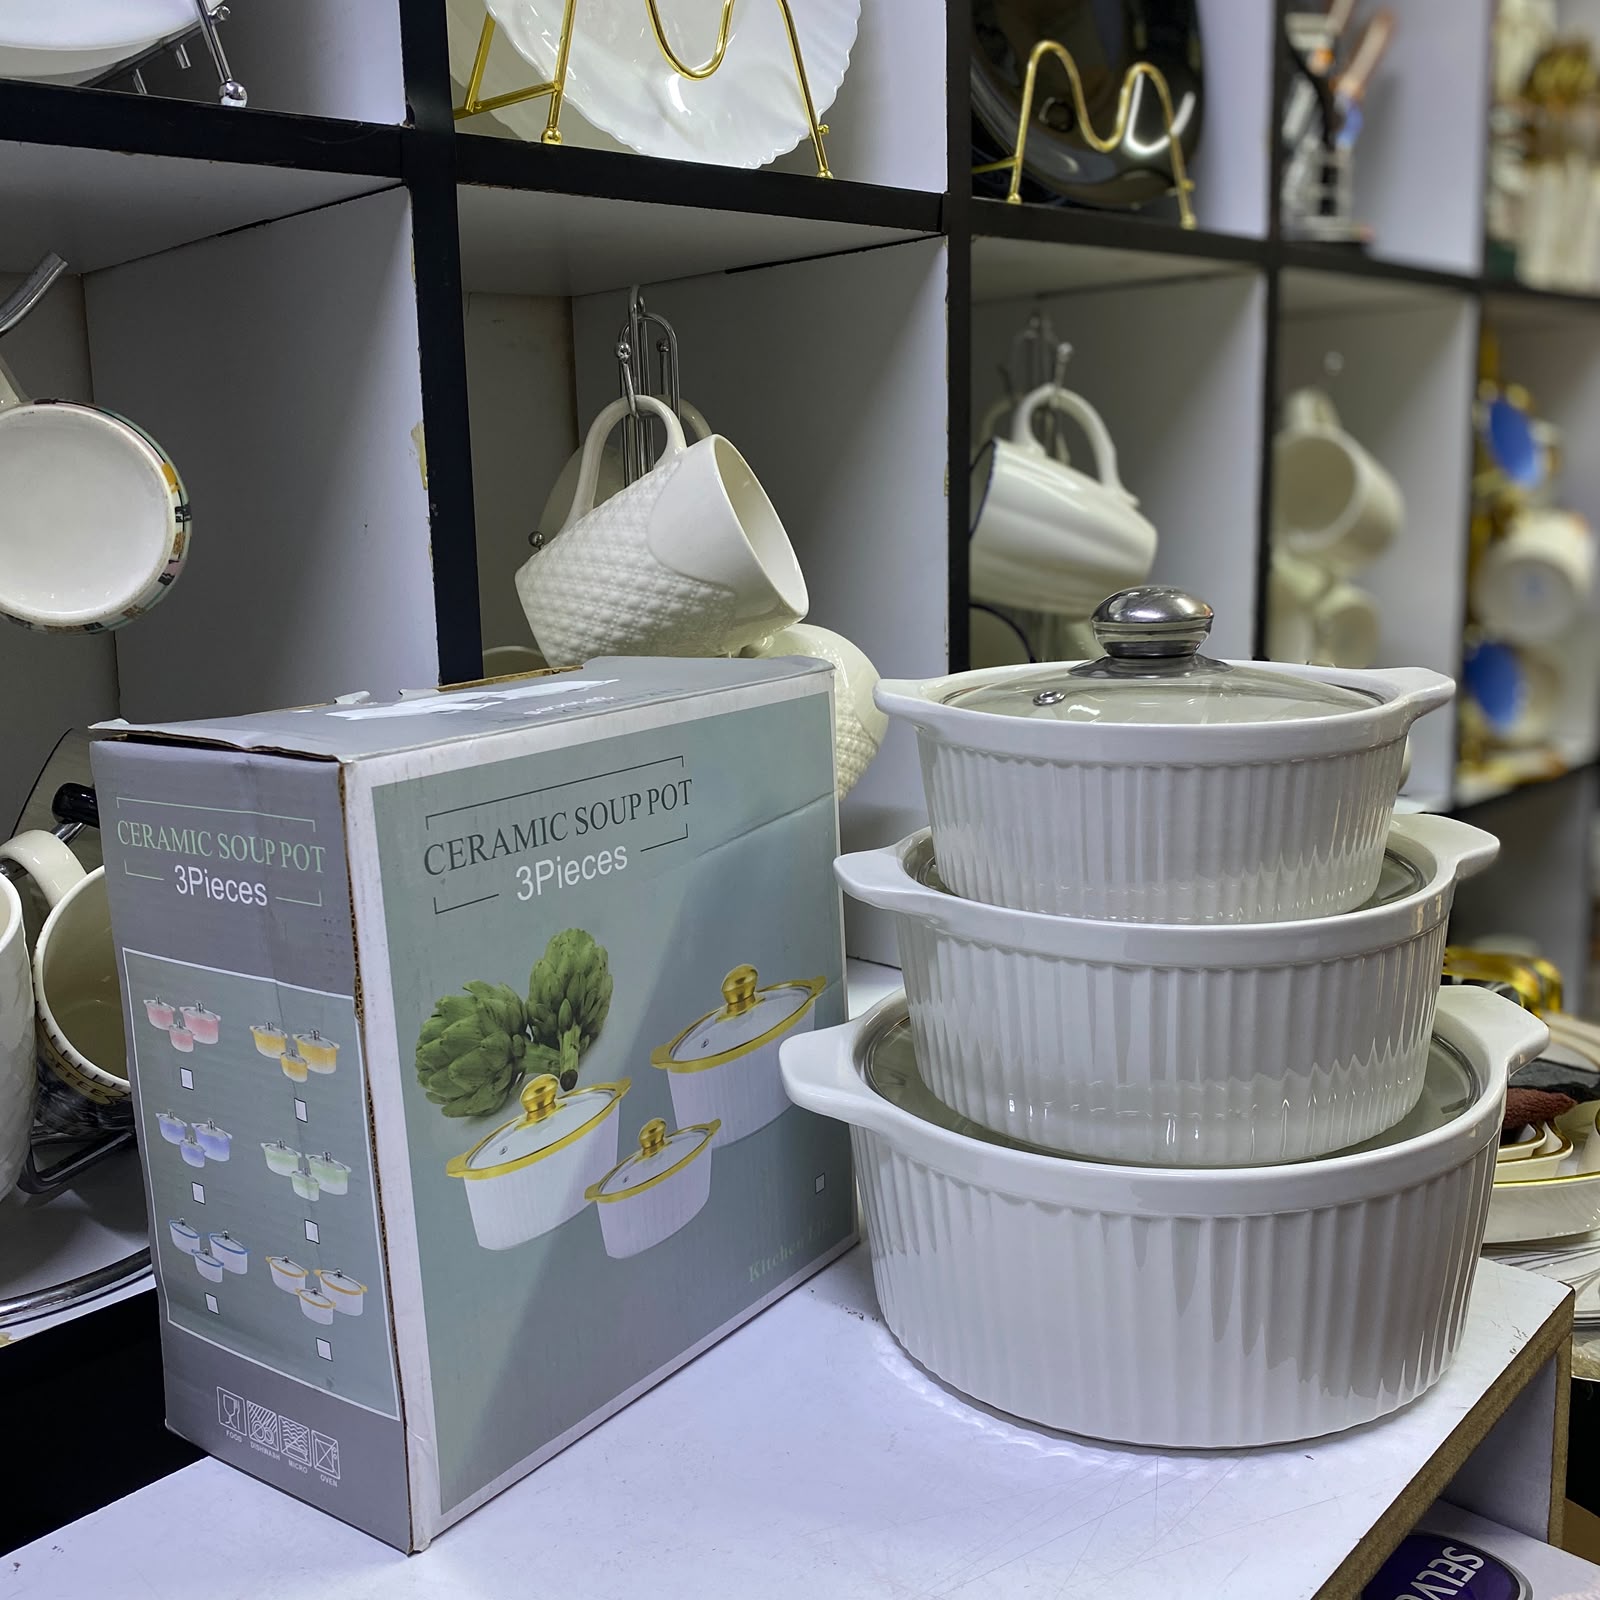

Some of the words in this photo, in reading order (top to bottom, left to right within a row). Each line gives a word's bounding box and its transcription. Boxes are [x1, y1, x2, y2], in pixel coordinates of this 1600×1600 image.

[117, 819, 213, 858] CERAMIC
[217, 832, 276, 866] SOUP
[280, 841, 326, 874] POT
[424, 811, 568, 876] CERAMIC
[574, 792, 642, 837] SOUP
[647, 778, 693, 817] POT
[174, 864, 268, 907] 3Pieces
[515, 845, 628, 901] 3Pieces
[288, 1459, 308, 1474] MICRO
[320, 1473, 338, 1488] OVEN
[1394, 1546, 1485, 1600] SELV
